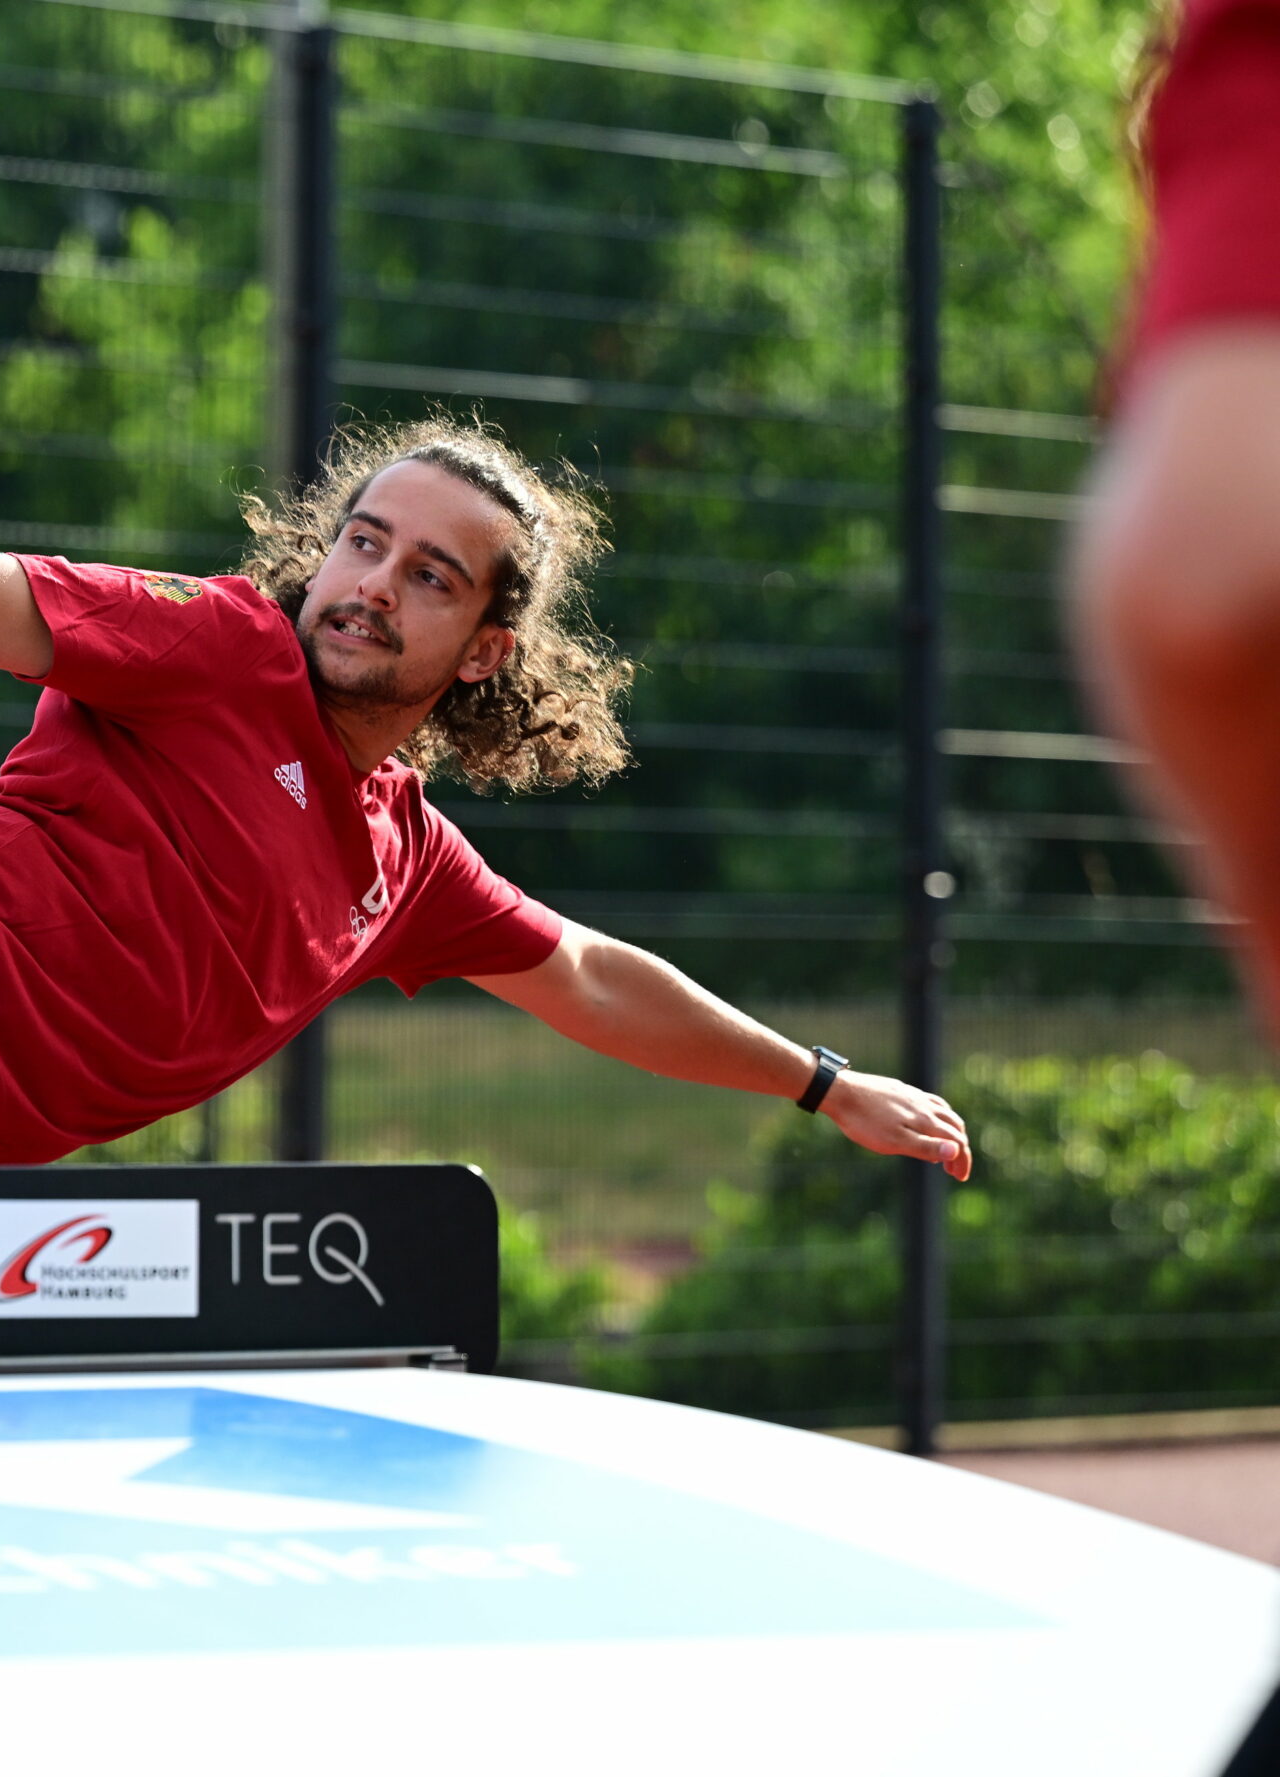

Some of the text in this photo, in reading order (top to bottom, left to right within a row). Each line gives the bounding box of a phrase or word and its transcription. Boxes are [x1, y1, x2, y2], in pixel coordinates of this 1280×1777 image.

[274, 767, 308, 810] adidas
[215, 1212, 385, 1307] TEQ
[41, 1286, 126, 1301] HAMBURG
